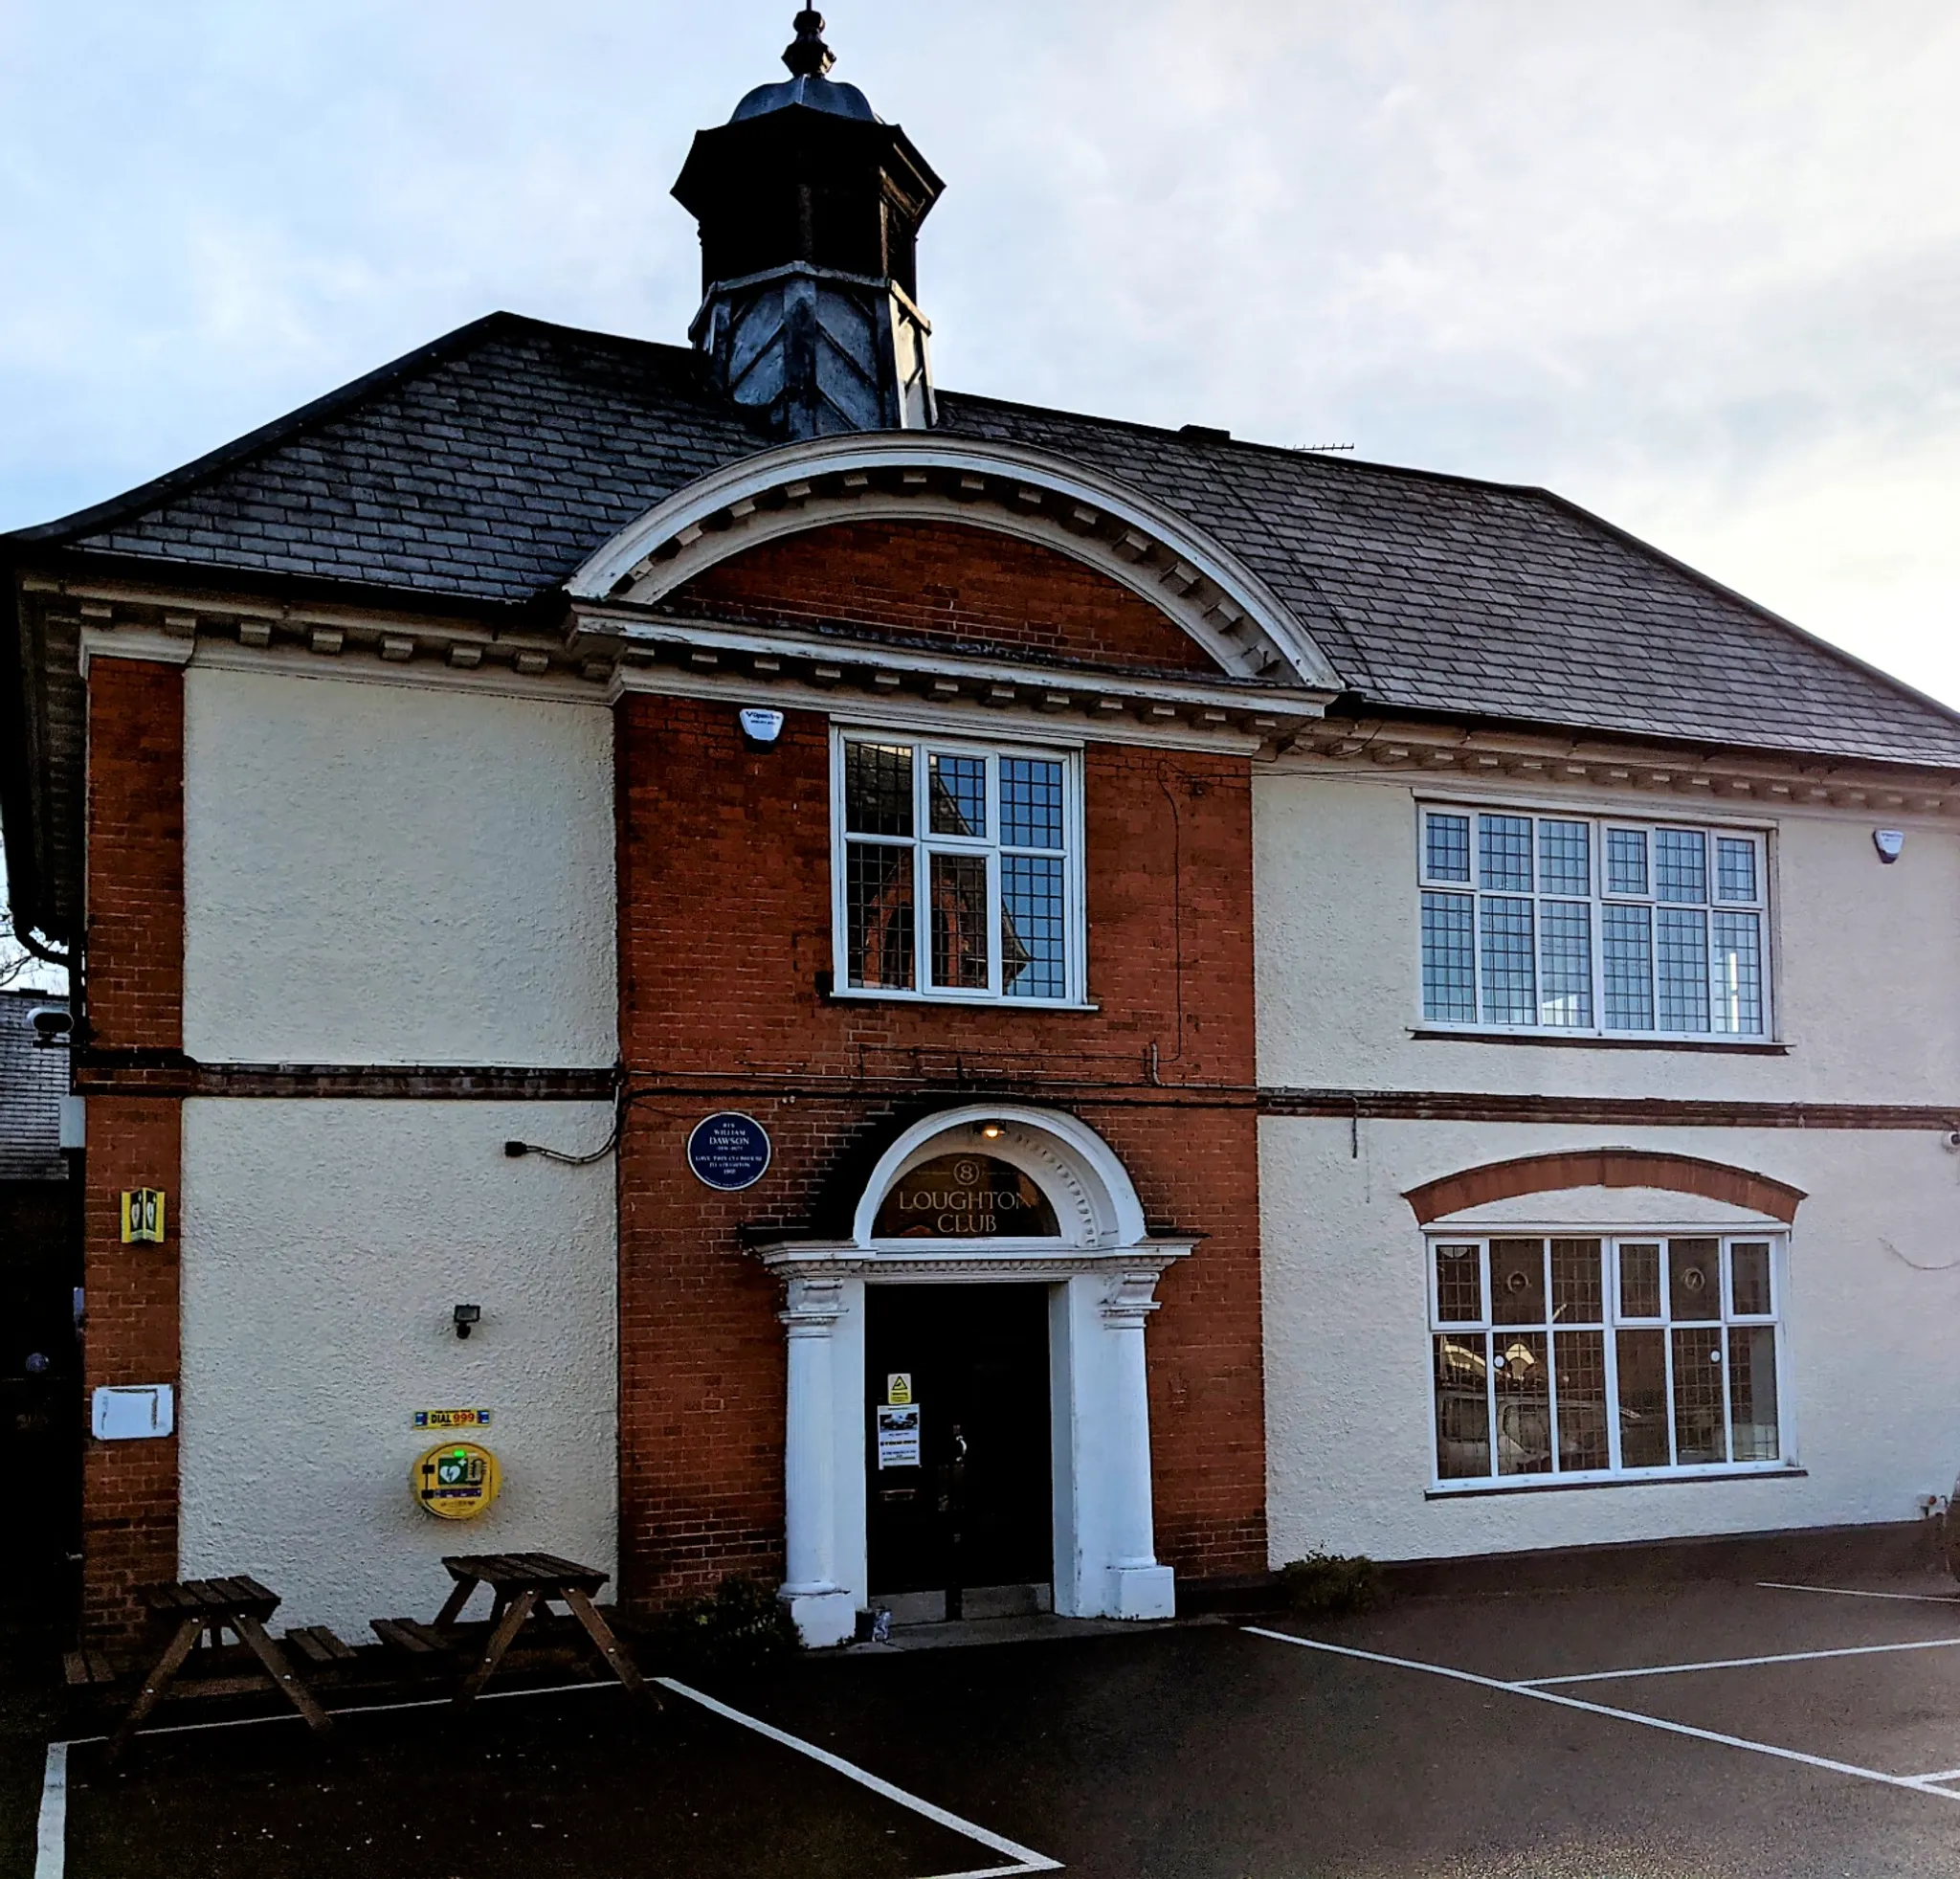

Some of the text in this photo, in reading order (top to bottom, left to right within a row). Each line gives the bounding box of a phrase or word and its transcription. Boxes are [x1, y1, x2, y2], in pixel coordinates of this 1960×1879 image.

[900, 1191, 1033, 1210] LOUGHTON
[937, 1214, 997, 1233] CLUB
[431, 1413, 475, 1423] DIAL 999
